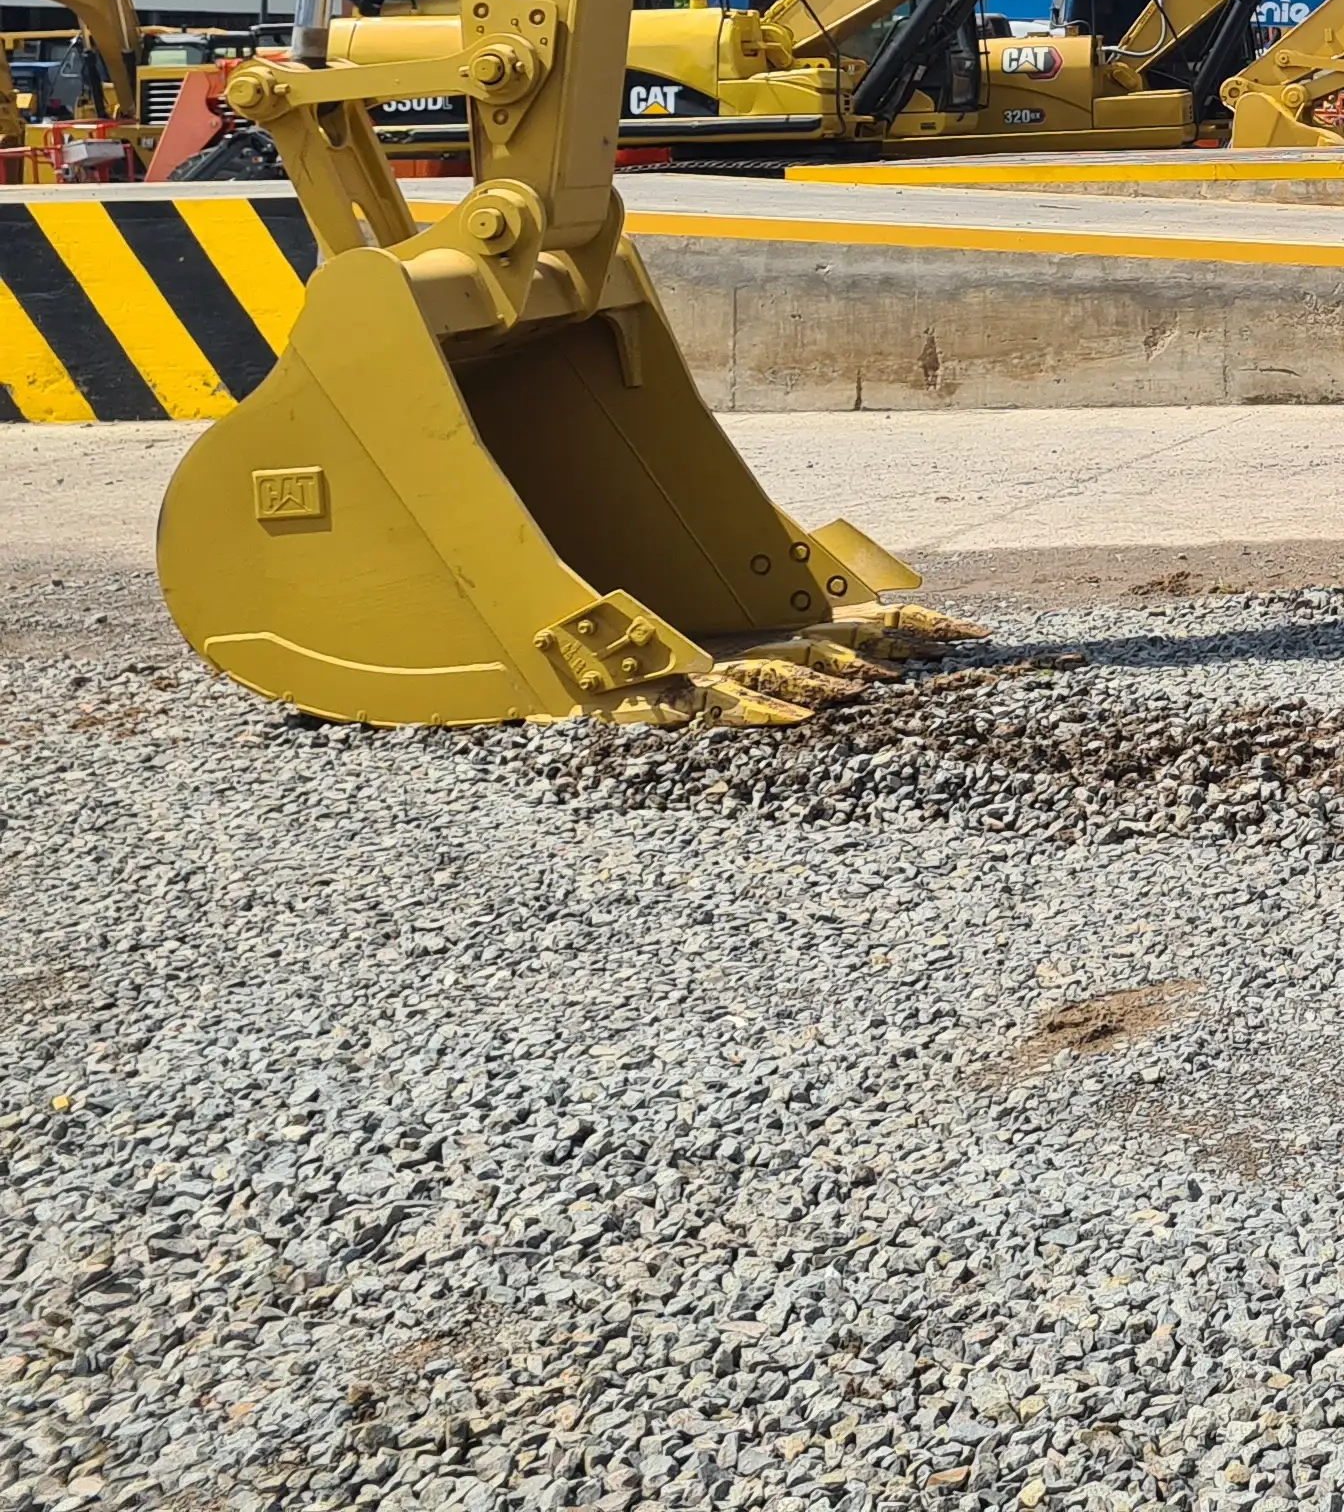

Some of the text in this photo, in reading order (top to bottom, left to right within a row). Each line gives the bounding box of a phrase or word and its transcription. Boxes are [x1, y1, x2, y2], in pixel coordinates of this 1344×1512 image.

[1003, 46, 1049, 73] CAT
[630, 85, 681, 115] CAT
[260, 475, 315, 515] CAT
